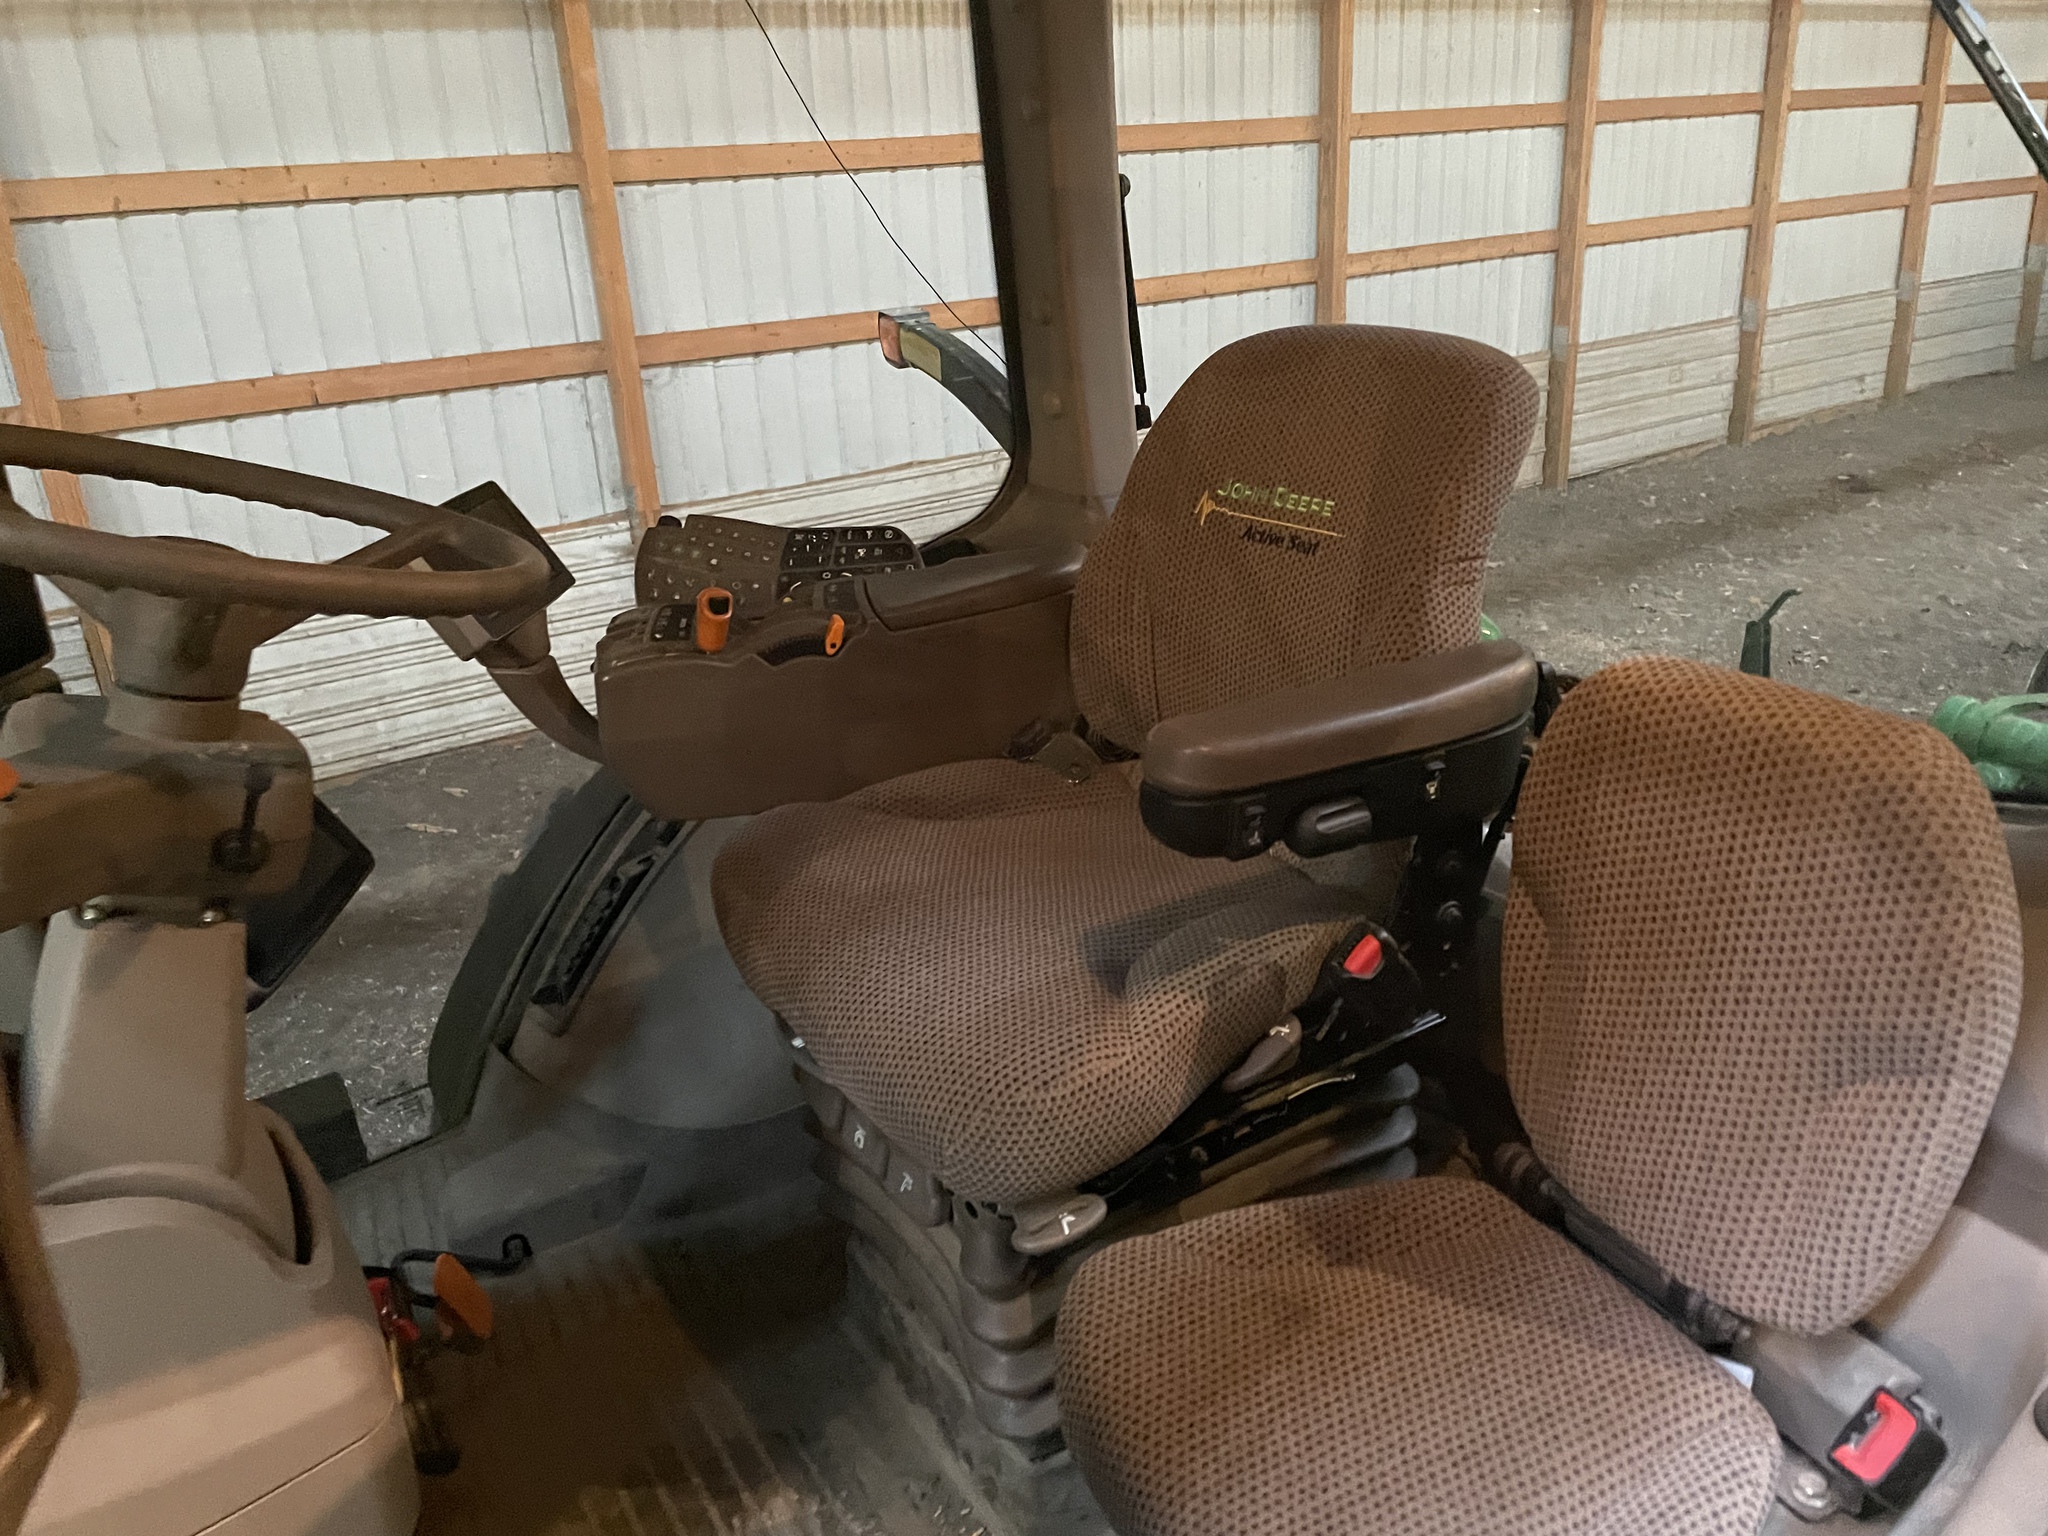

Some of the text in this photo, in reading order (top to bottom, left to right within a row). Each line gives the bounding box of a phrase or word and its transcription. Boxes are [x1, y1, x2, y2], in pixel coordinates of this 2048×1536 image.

[1217, 479, 1335, 516] JOHN DEERE
[1241, 523, 1320, 556] Active Seat
